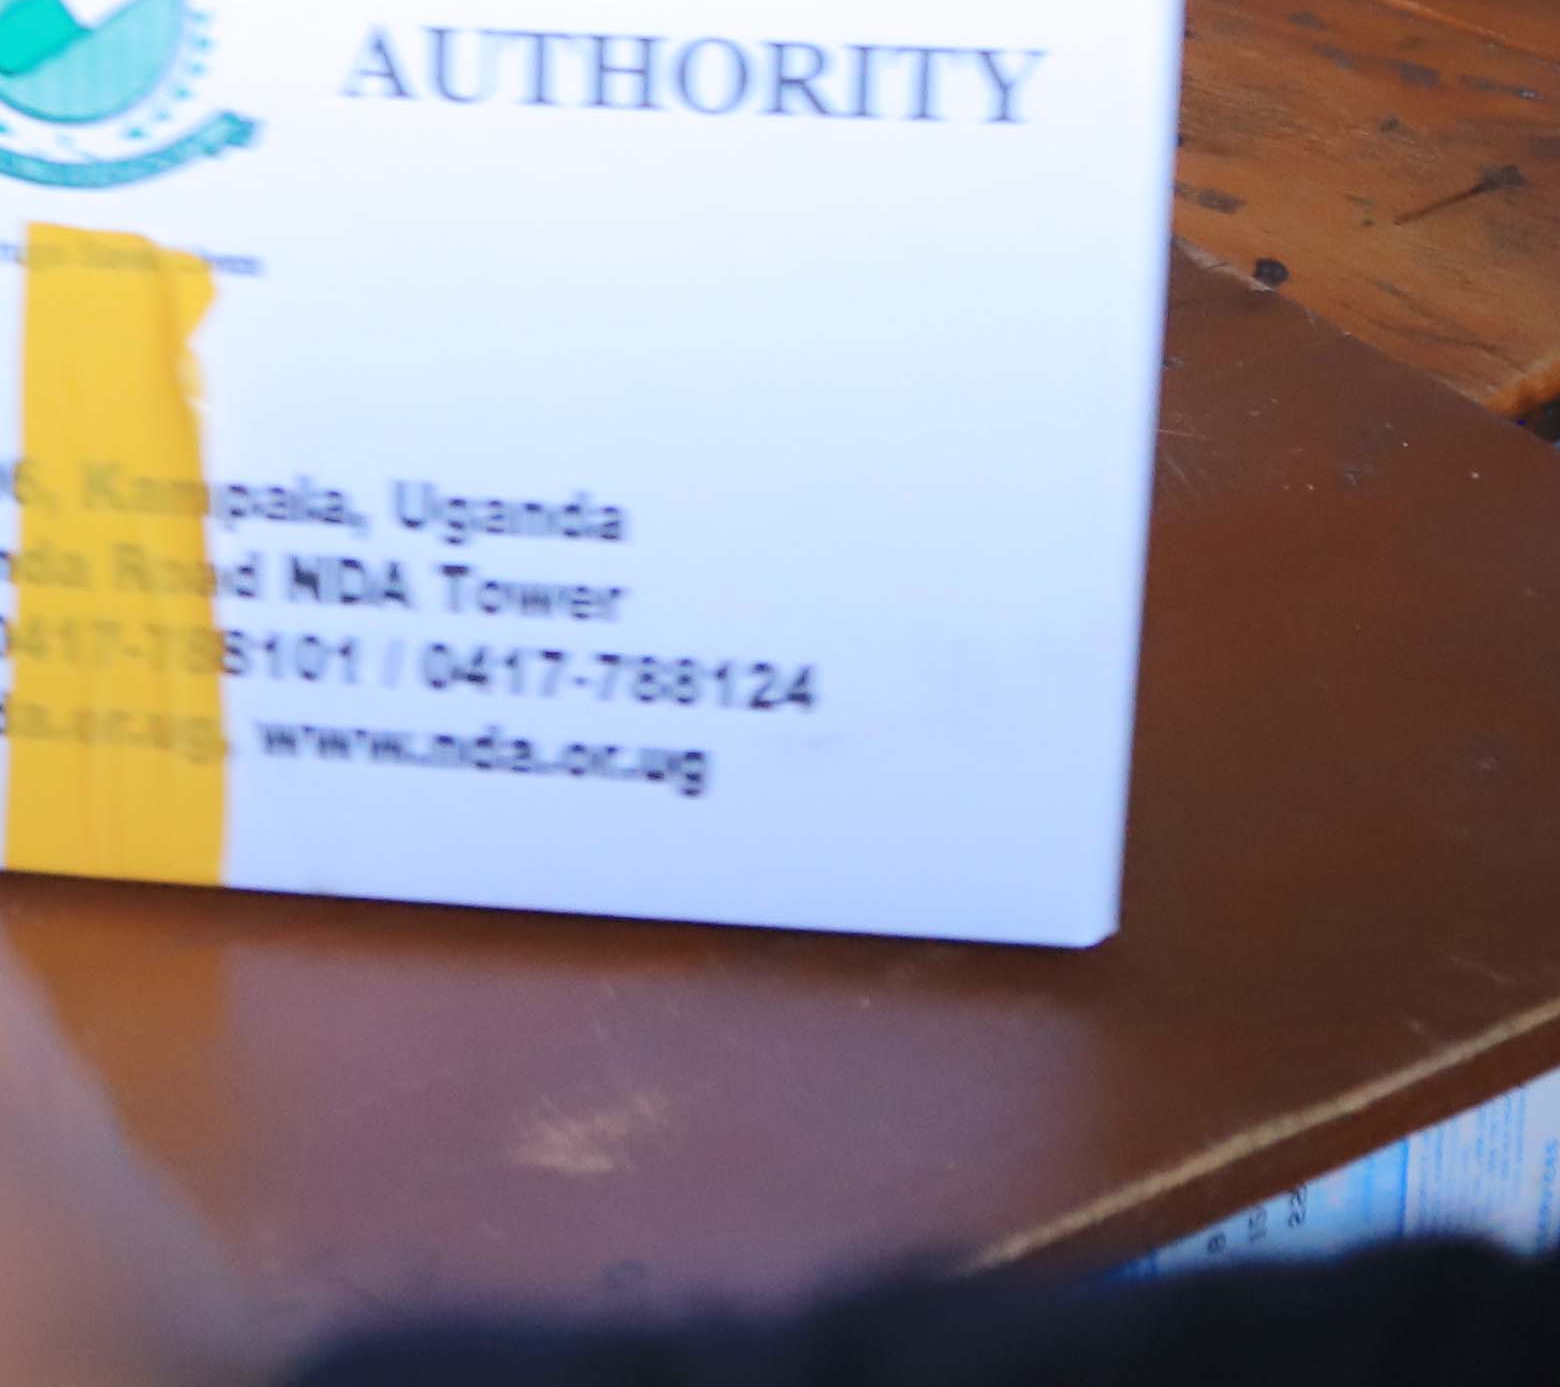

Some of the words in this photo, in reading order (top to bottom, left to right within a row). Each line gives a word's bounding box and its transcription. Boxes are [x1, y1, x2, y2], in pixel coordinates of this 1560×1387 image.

[339, 23, 1050, 125] AUTHORITY
[393, 479, 628, 547] Uganda
[286, 551, 414, 611] NDA
[436, 562, 628, 623] Tower
